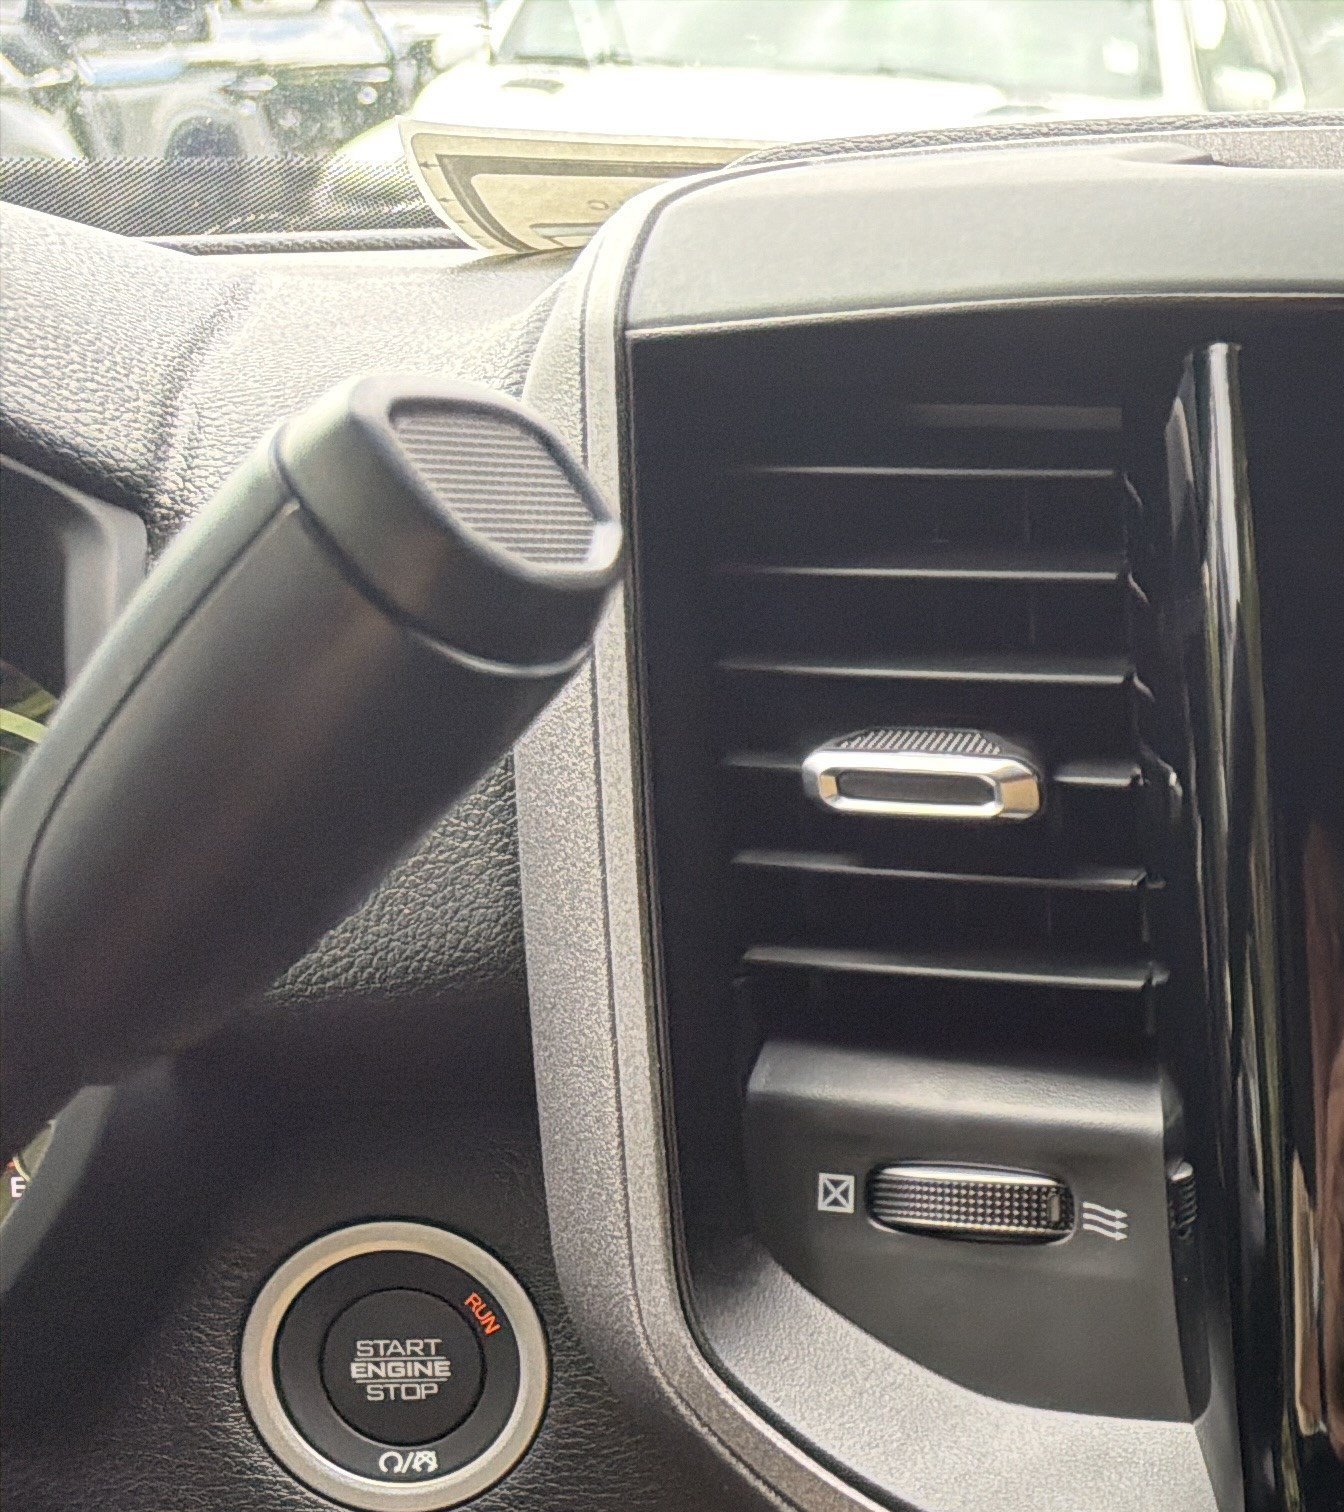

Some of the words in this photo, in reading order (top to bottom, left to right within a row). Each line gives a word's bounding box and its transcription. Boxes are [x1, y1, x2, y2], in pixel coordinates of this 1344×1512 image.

[10, 1176, 26, 1198] E
[464, 1291, 501, 1336] RUN
[355, 1339, 443, 1357] START
[350, 1360, 452, 1378] ENGINE
[366, 1383, 439, 1401] STOP
